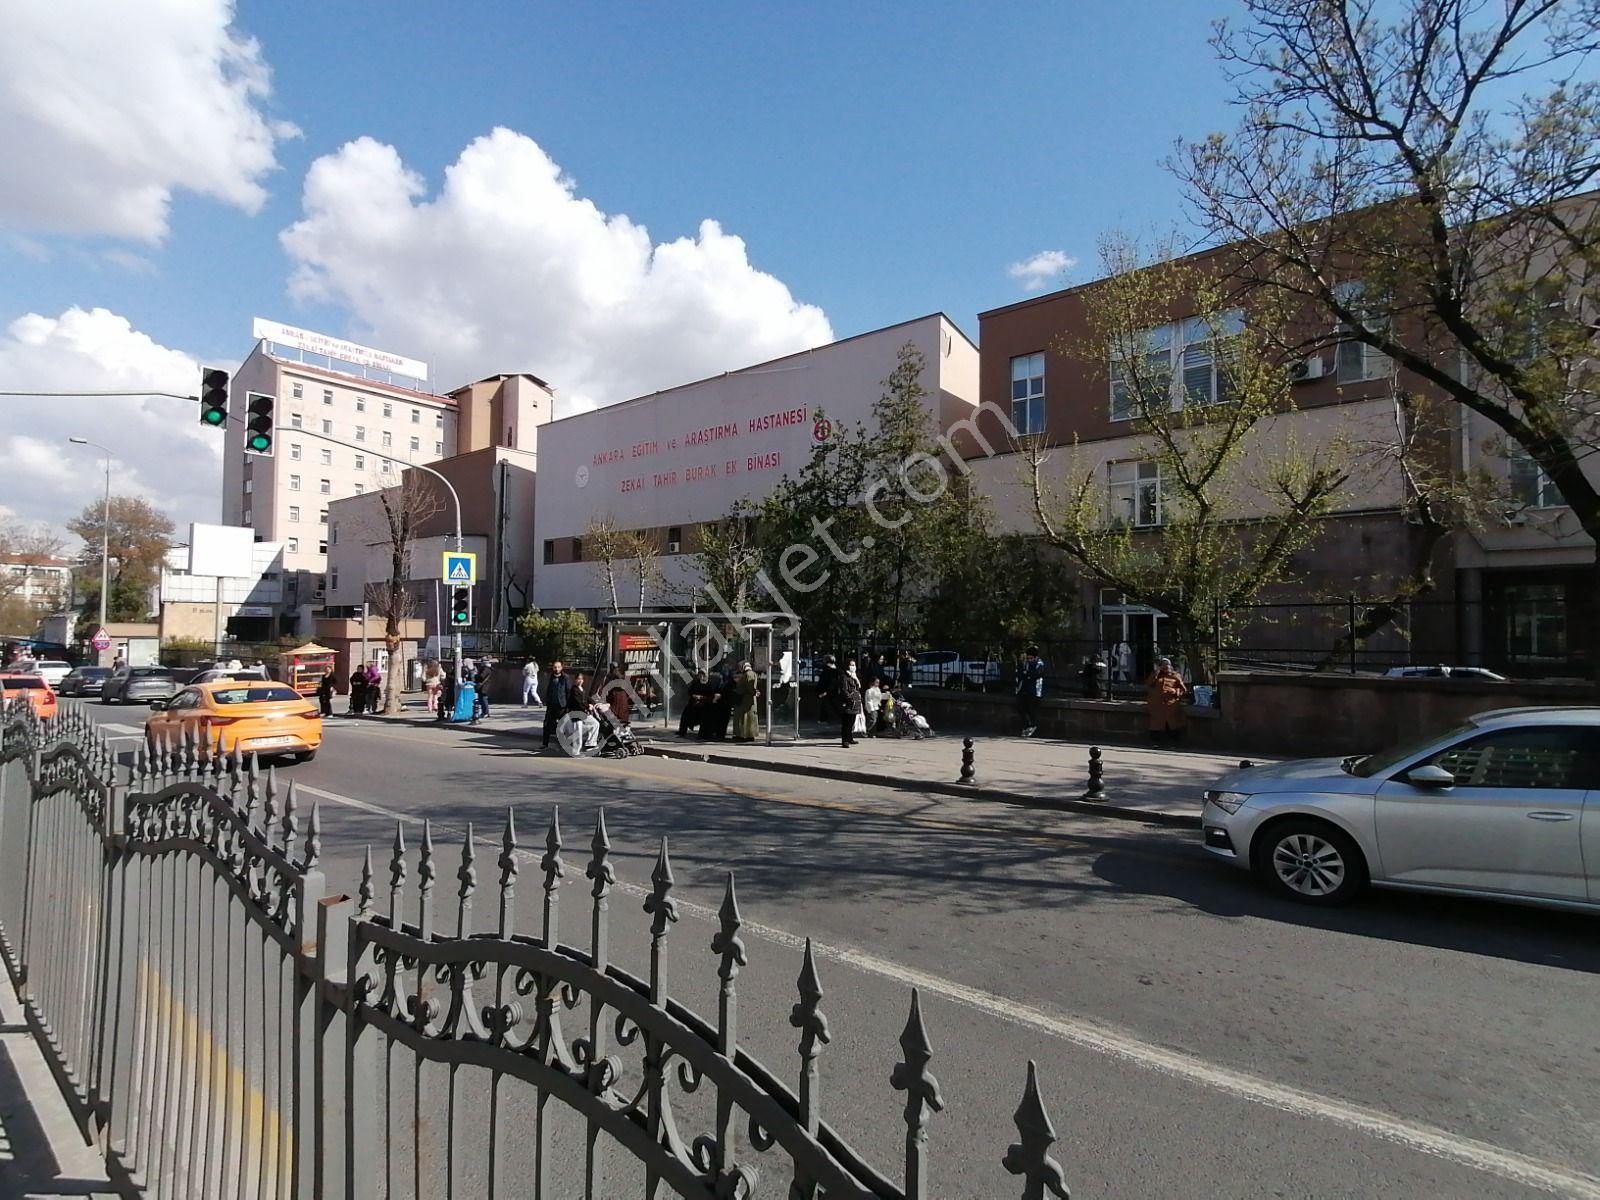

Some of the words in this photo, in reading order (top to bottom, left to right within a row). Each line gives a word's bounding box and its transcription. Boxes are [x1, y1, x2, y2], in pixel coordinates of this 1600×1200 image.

[592, 449, 624, 466] ANKARA
[667, 439, 677, 450] ve
[685, 423, 738, 446] ARAŞTIRMA
[749, 402, 807, 432] HASTANESİ
[685, 464, 716, 481] BURAK
[726, 460, 737, 474] EK
[747, 452, 780, 471] BİNASI
